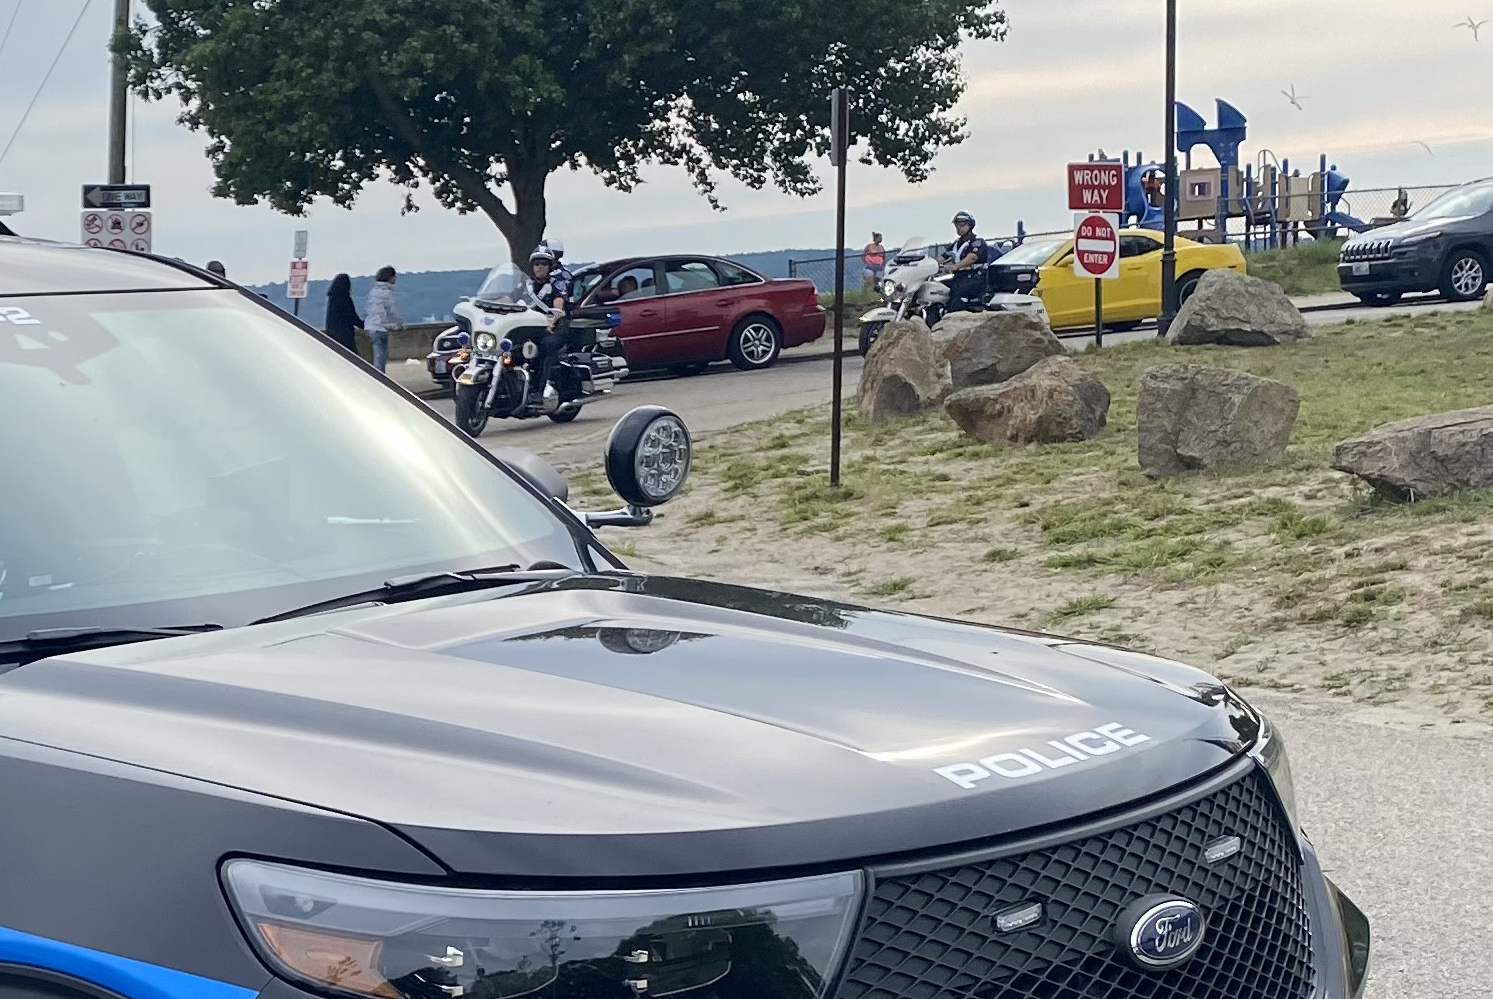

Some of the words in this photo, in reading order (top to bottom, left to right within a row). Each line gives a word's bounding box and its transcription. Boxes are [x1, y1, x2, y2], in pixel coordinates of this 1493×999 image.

[1074, 170, 1117, 185] WRONG
[1082, 189, 1109, 204] WAY
[1081, 226, 1092, 236] DO
[1096, 227, 1111, 237] NOT
[1083, 253, 1108, 264] ENTER
[932, 721, 1152, 790] POLICE
[1155, 913, 1193, 953] Ford
